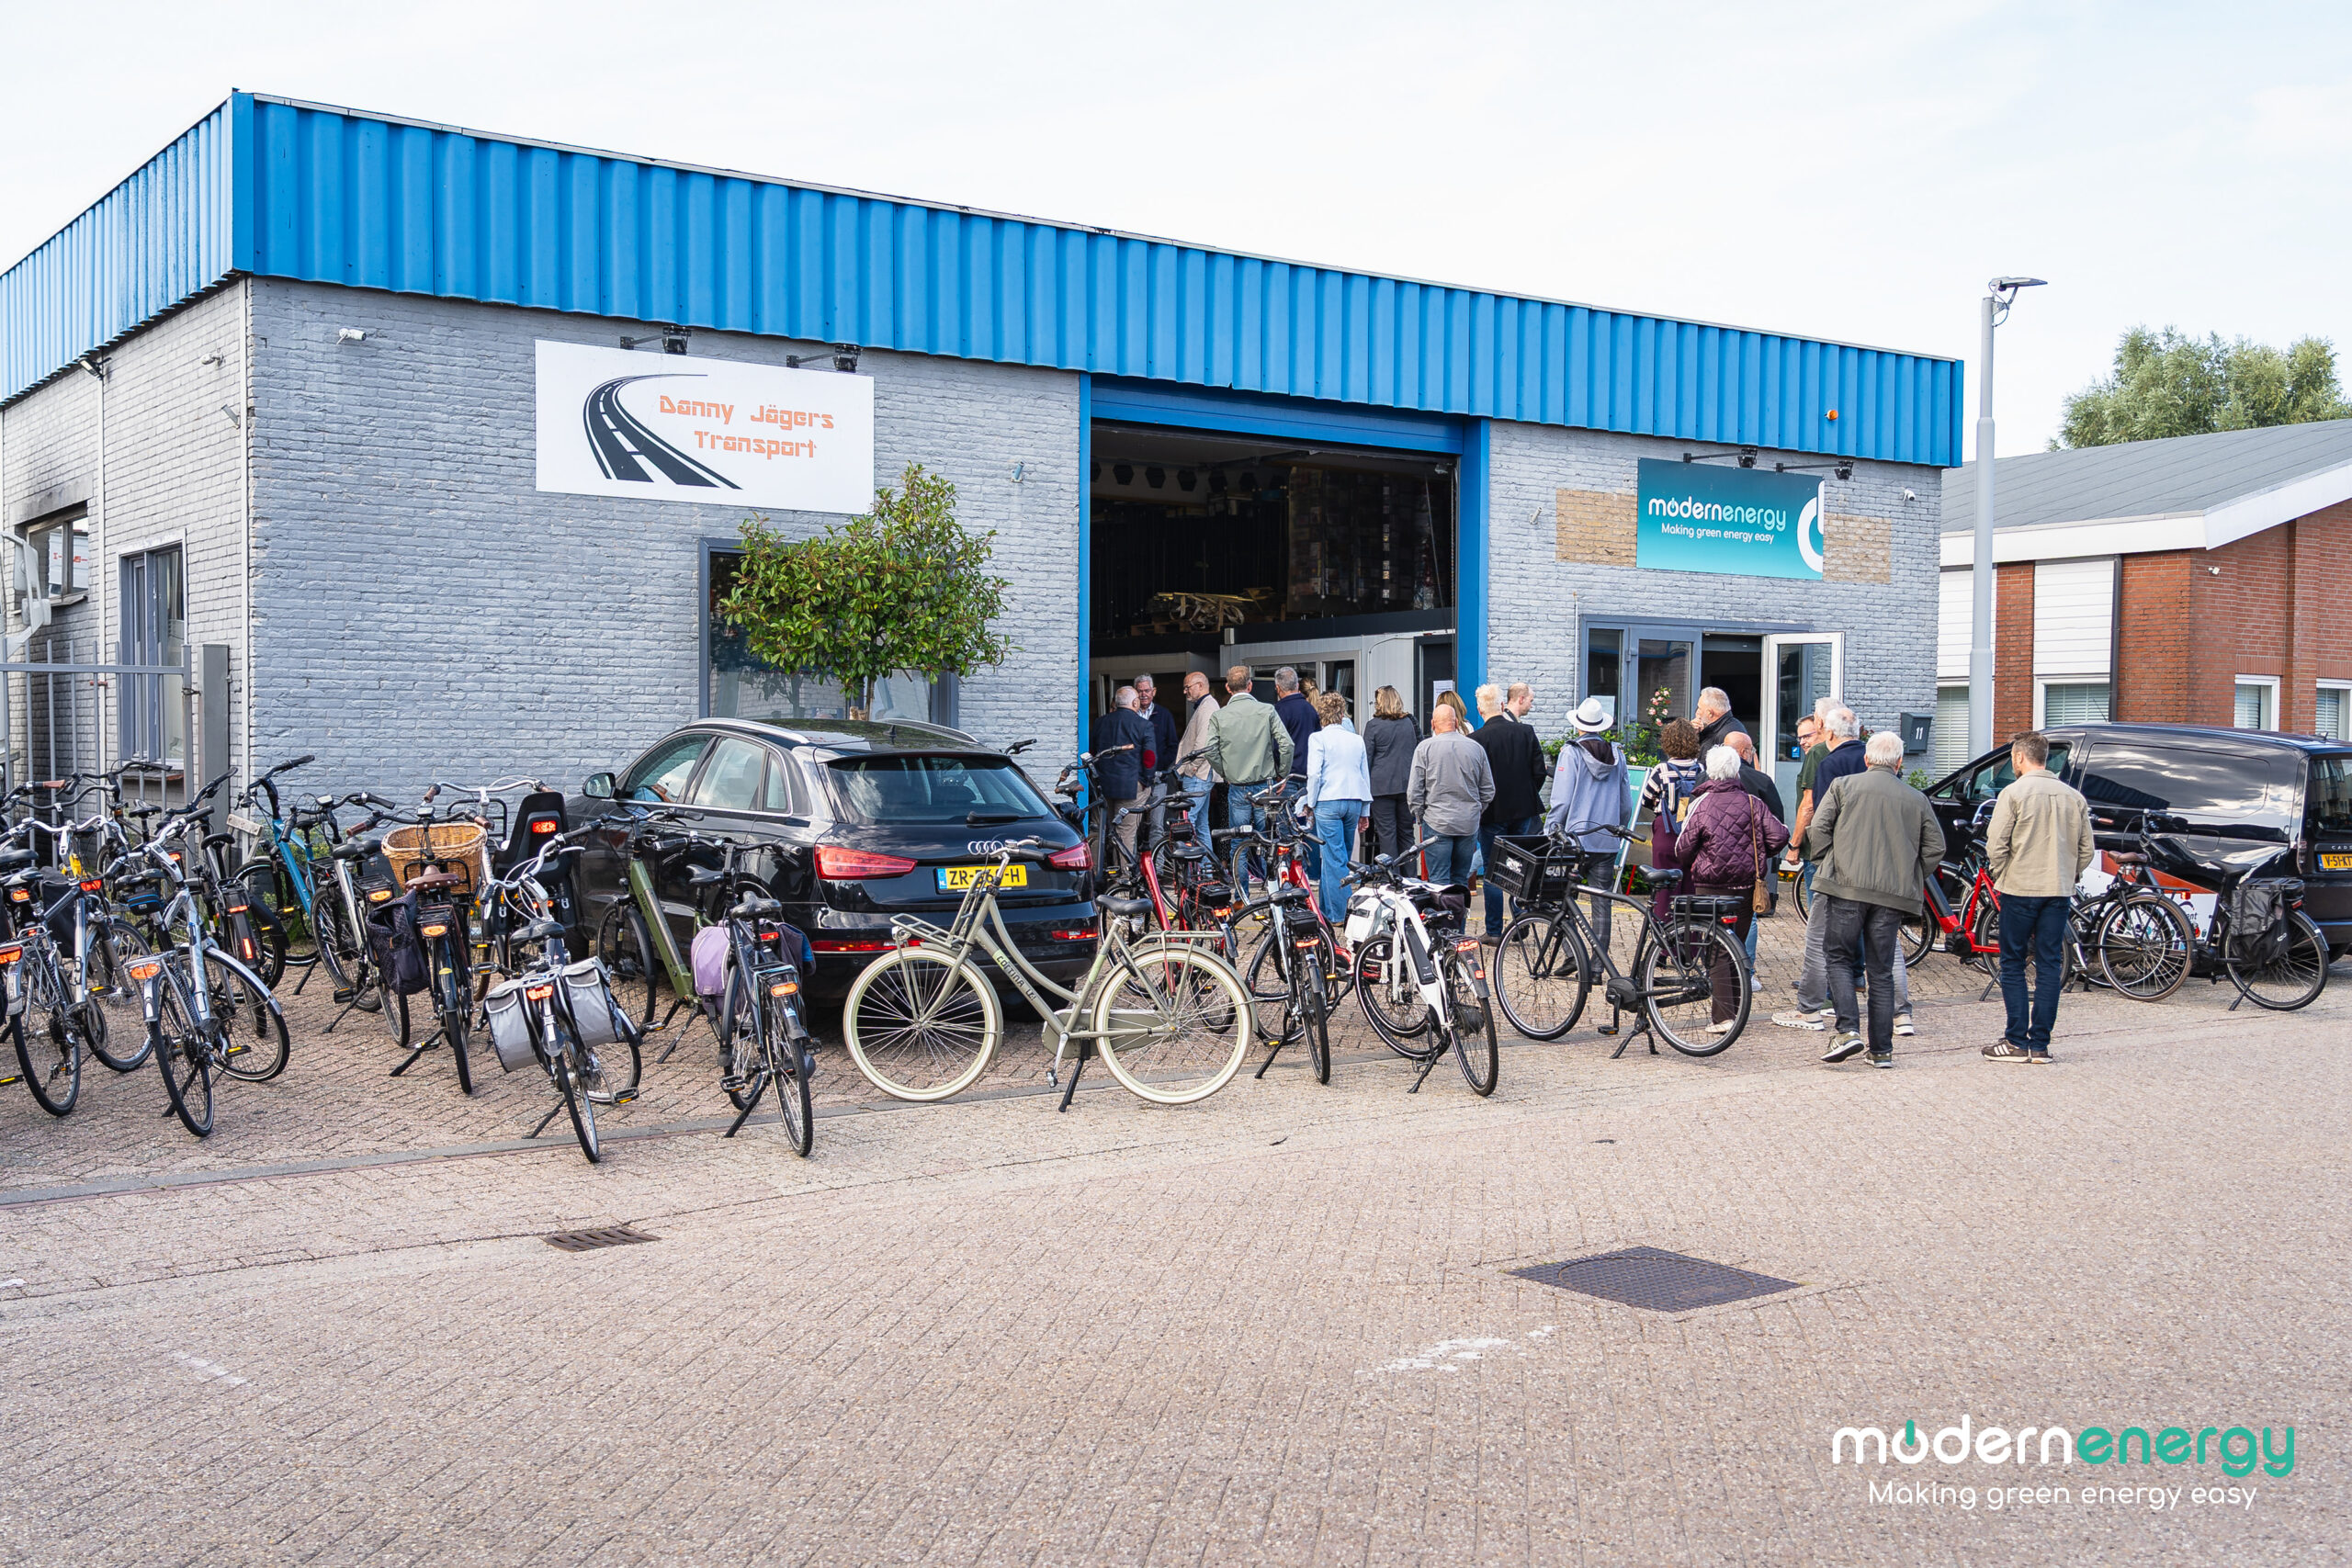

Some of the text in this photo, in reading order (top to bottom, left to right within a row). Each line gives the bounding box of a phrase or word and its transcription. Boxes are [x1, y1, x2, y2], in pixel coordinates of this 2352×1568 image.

[660, 395, 834, 431] Danny Jägers
[694, 430, 818, 460] Transport
[1648, 496, 1786, 532] modernenergy
[1661, 523, 1774, 545] Making green energy easy
[1916, 727, 1924, 740] 11
